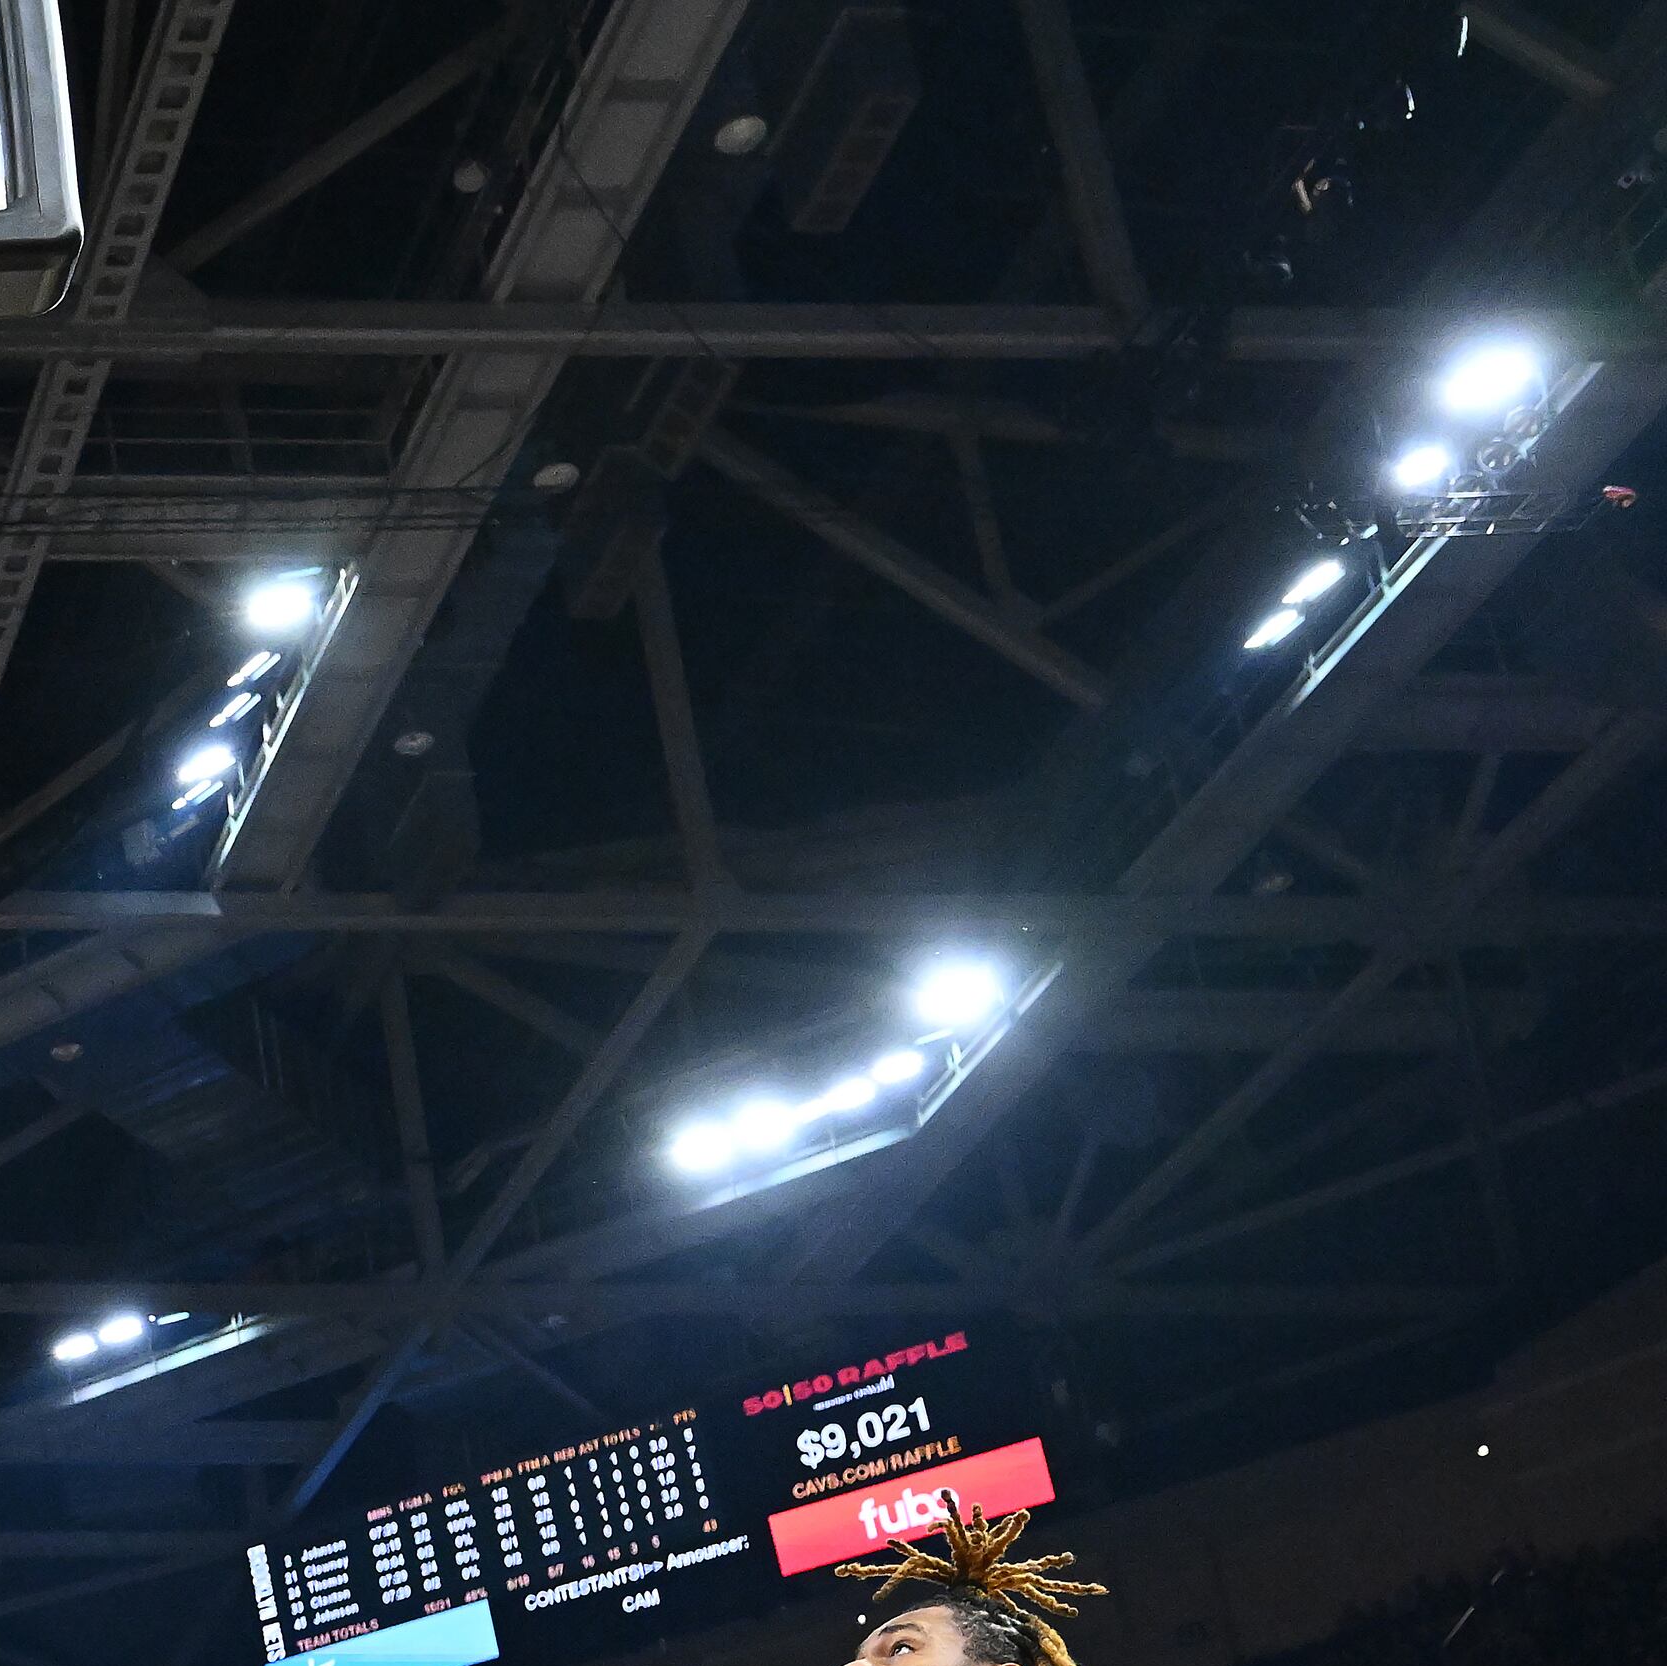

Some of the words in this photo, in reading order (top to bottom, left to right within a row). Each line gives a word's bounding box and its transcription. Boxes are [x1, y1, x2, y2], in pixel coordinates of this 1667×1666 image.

[837, 1330, 969, 1387] RAFFLE
[796, 1396, 931, 1470] $9,021
[792, 1435, 962, 1500] CAVS.COM/RAFFLE
[857, 1486, 960, 1540] fubo
[301, 1540, 347, 1563] Johnson
[304, 1556, 349, 1579] Clowney
[667, 1535, 750, 1571] Announcer:
[307, 1572, 349, 1594] Thomas
[313, 1602, 360, 1626] Johnson
[622, 1588, 661, 1613] CAM
[297, 1630, 332, 1652] TEAM
[332, 1618, 379, 1644] TOTALS
